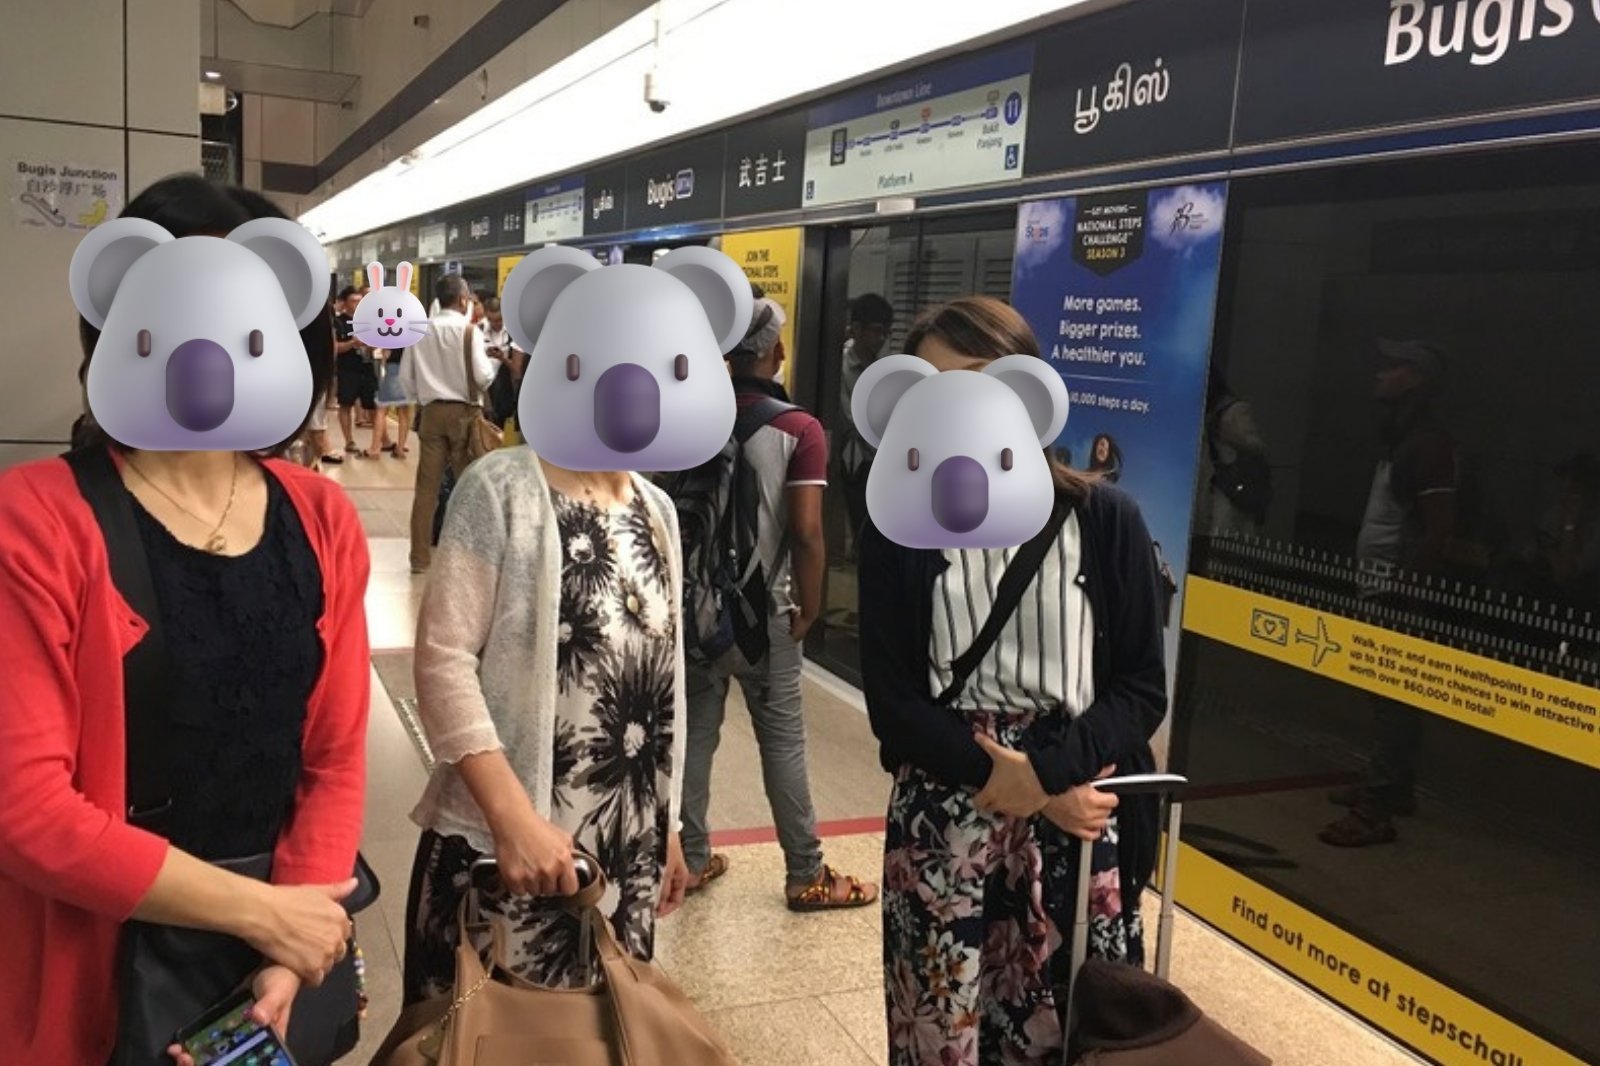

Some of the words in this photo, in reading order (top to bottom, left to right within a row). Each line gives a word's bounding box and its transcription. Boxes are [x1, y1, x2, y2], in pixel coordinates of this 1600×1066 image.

[1384, 0, 1574, 65] Bugis
[915, 83, 931, 98] Line
[1073, 57, 1170, 134] பூகிஸ்
[17, 162, 56, 177] Bugis
[60, 166, 117, 180] Junction
[738, 150, 787, 188] 武吉士
[878, 174, 907, 190] Platform
[908, 171, 914, 185] A
[647, 173, 676, 209] Bugis
[1076, 220, 1117, 233] NATIONAL
[1118, 216, 1142, 230] STEPS
[1086, 247, 1118, 260] SEASON
[1063, 295, 1093, 311] More
[1095, 296, 1142, 315] games.
[1059, 319, 1097, 339] Bigger
[1099, 321, 1142, 341] prizes.
[1051, 344, 1060, 360] A
[1062, 345, 1116, 364] healthier
[1119, 351, 1146, 368] you.
[1098, 394, 1121, 410] steps
[1122, 399, 1129, 410] a
[1349, 663, 1377, 679] worth
[1378, 673, 1401, 687] over
[1403, 679, 1450, 703] $60,000
[1451, 694, 1462, 706] in
[1352, 634, 1379, 651] Walk,
[1381, 644, 1403, 657] sync
[1406, 651, 1426, 664] and
[1427, 659, 1452, 672] earn
[1455, 664, 1528, 695] Healthpoints
[1531, 687, 1544, 700] to
[1547, 694, 1597, 716] redeem
[1350, 650, 1362, 662] up
[1364, 653, 1375, 664] to
[1398, 664, 1418, 677] and
[1420, 671, 1444, 685] earn
[1446, 679, 1491, 700] chances
[1495, 692, 1507, 705] to
[1510, 698, 1532, 713] win
[1534, 706, 1595, 733] attractive
[1231, 895, 1268, 931] Find
[1272, 922, 1304, 951] out
[1306, 943, 1361, 985] more
[1367, 978, 1391, 1002] at
